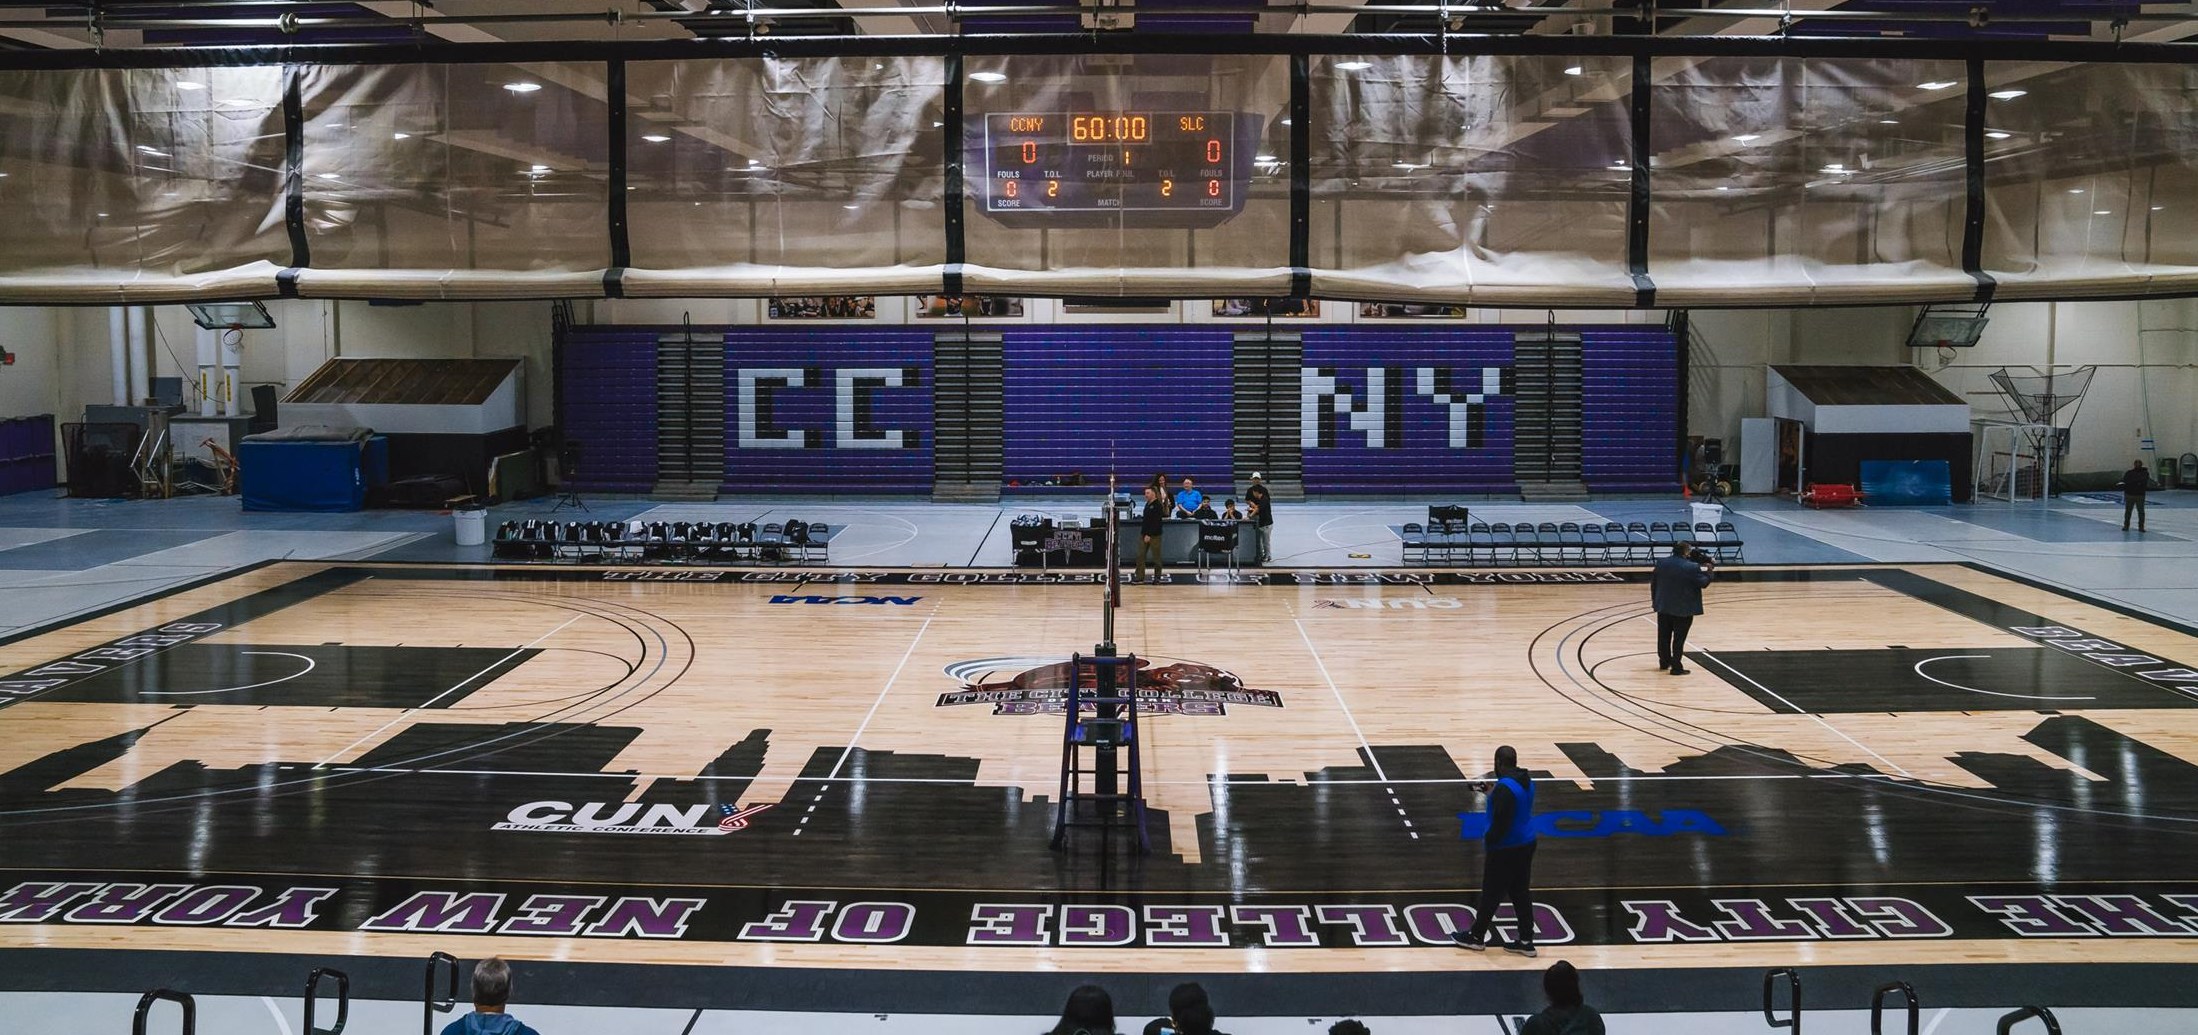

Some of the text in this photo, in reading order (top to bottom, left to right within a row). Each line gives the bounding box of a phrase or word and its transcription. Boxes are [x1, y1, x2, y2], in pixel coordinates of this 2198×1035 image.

[1010, 116, 1043, 132] CCNY
[1073, 117, 1146, 140] 60:00
[1180, 116, 1204, 131] SLC
[1022, 141, 1036, 163] 0
[1088, 151, 1130, 164] PERIOD 1
[1207, 140, 1221, 163] 0
[997, 171, 1020, 179] FOULS
[1086, 171, 1113, 179] PLAYER
[1200, 169, 1223, 178] FOULS
[1006, 181, 1016, 197] 0
[1048, 181, 1057, 197] 2
[1161, 180, 1172, 196] 2
[1209, 180, 1219, 196] 0
[997, 200, 1020, 208] SCORE
[0, 622, 222, 703] AVERS
[2009, 626, 2198, 697] BEAV
[499, 823, 709, 834] ATHLETIC CONFERENCE
[358, 889, 708, 938] NEW
[736, 900, 916, 942] OF
[1620, 896, 1954, 942] CITY
[1964, 894, 2198, 938] HE
[966, 902, 1575, 946] COLLEGE
